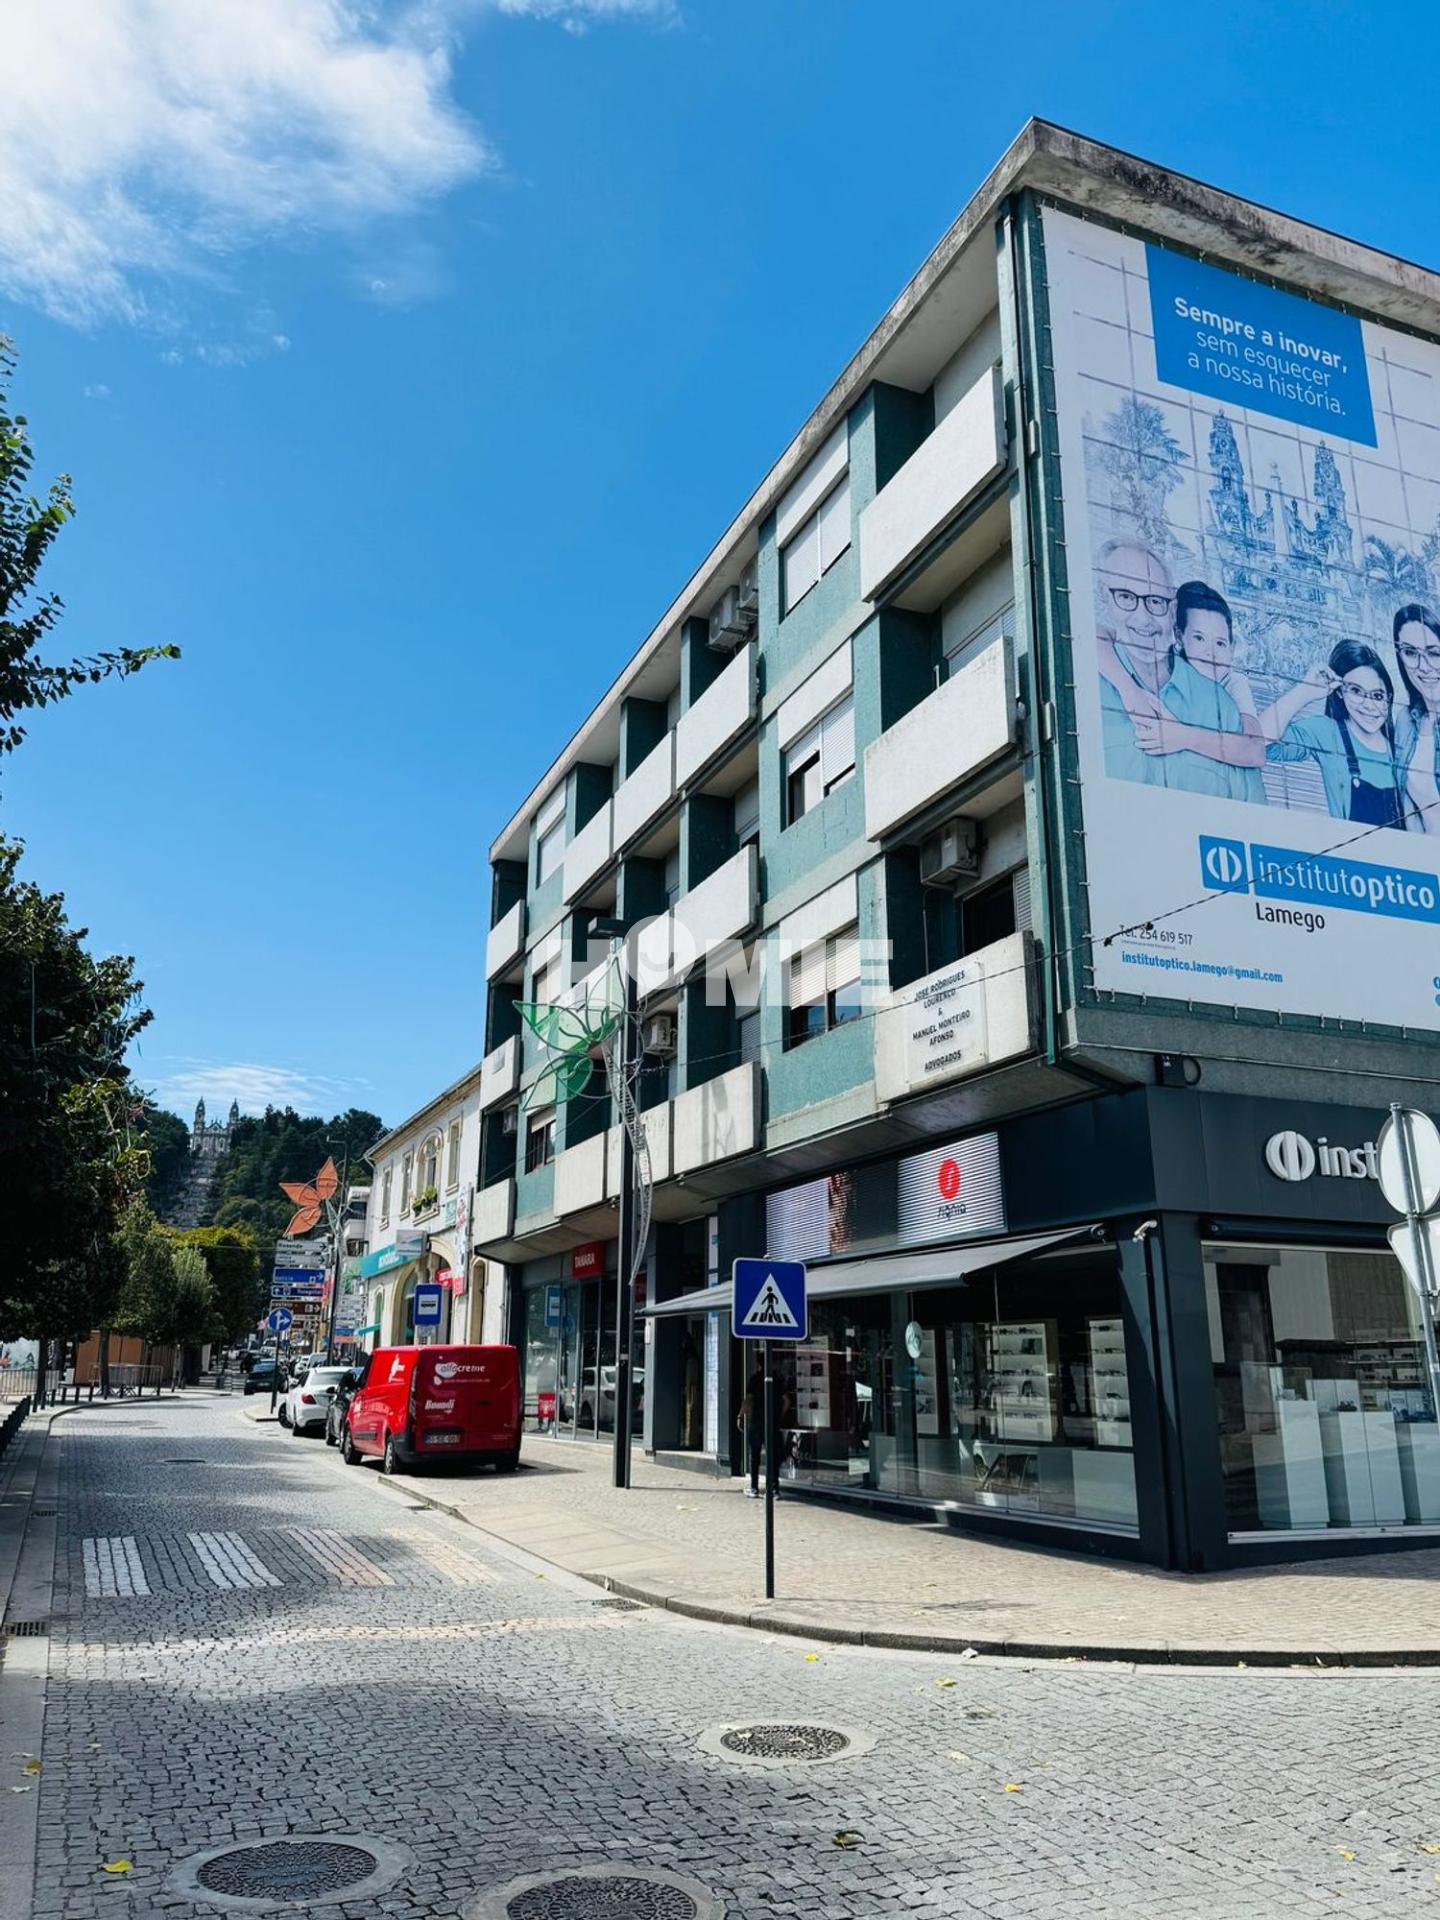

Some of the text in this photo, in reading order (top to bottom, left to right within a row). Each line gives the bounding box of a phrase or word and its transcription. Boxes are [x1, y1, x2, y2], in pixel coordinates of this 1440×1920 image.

[1174, 297, 1347, 373] Sempre a inovar,
[1196, 331, 1332, 387] sem esquecer
[1188, 352, 1347, 415] a nossa história.
[1258, 853, 1435, 909] institutoptico
[1255, 902, 1326, 933] Lamego
[1119, 925, 1137, 938] Tel.
[1139, 927, 1158, 940] 254
[1160, 930, 1176, 944] 619
[1178, 933, 1193, 946] 517
[931, 970, 965, 993] RODRIGUES
[1122, 951, 1284, 983] institutoptico.lamego@gmail.com
[912, 1009, 971, 1040] MANUEL MONTEIRO
[929, 1030, 954, 1046] AFONSO
[924, 1050, 962, 1072] ADVOGADOS
[1317, 1136, 1379, 1180] inst
